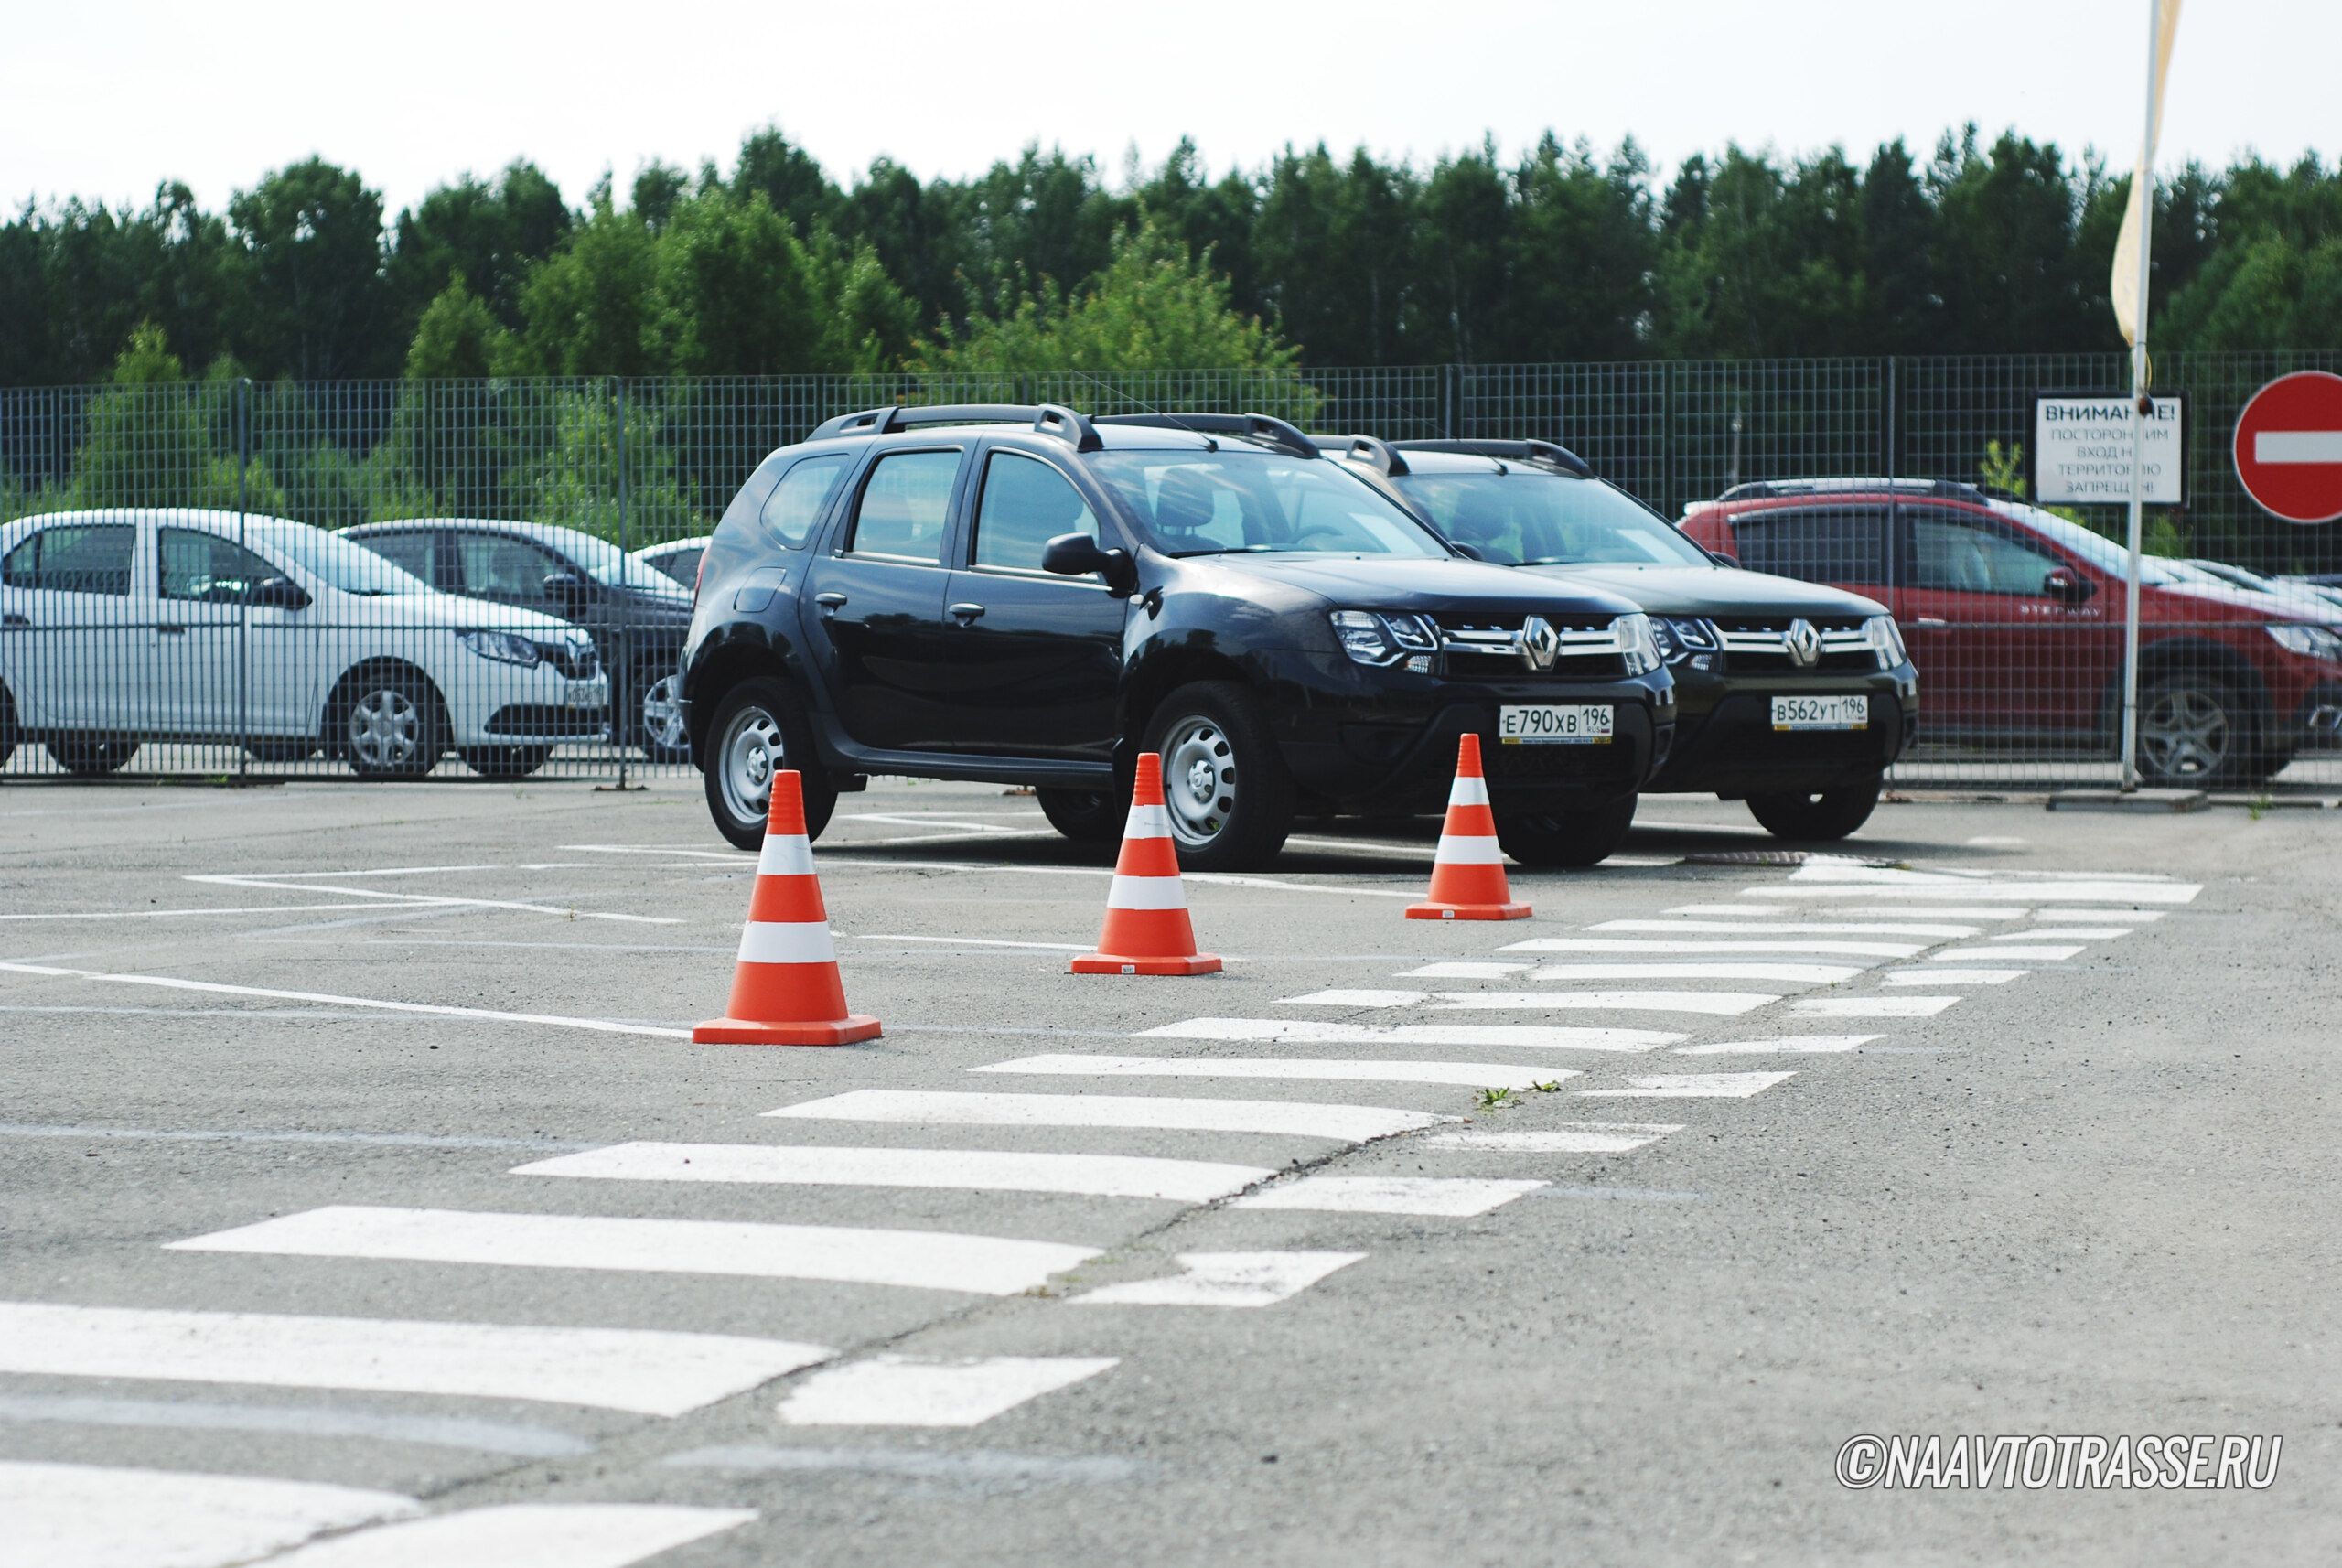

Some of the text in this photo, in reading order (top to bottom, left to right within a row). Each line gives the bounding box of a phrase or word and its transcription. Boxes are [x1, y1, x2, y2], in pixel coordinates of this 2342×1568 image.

[2051, 428, 2169, 441] ПОСТОРОНИМ
[2077, 446, 2118, 460] ВХОД
[2066, 481, 2154, 494] ЗАПРЕЩН!
[2021, 604, 2101, 616] STEPWAY
[1842, 698, 1865, 714] 196
[1582, 707, 1610, 726] 196
